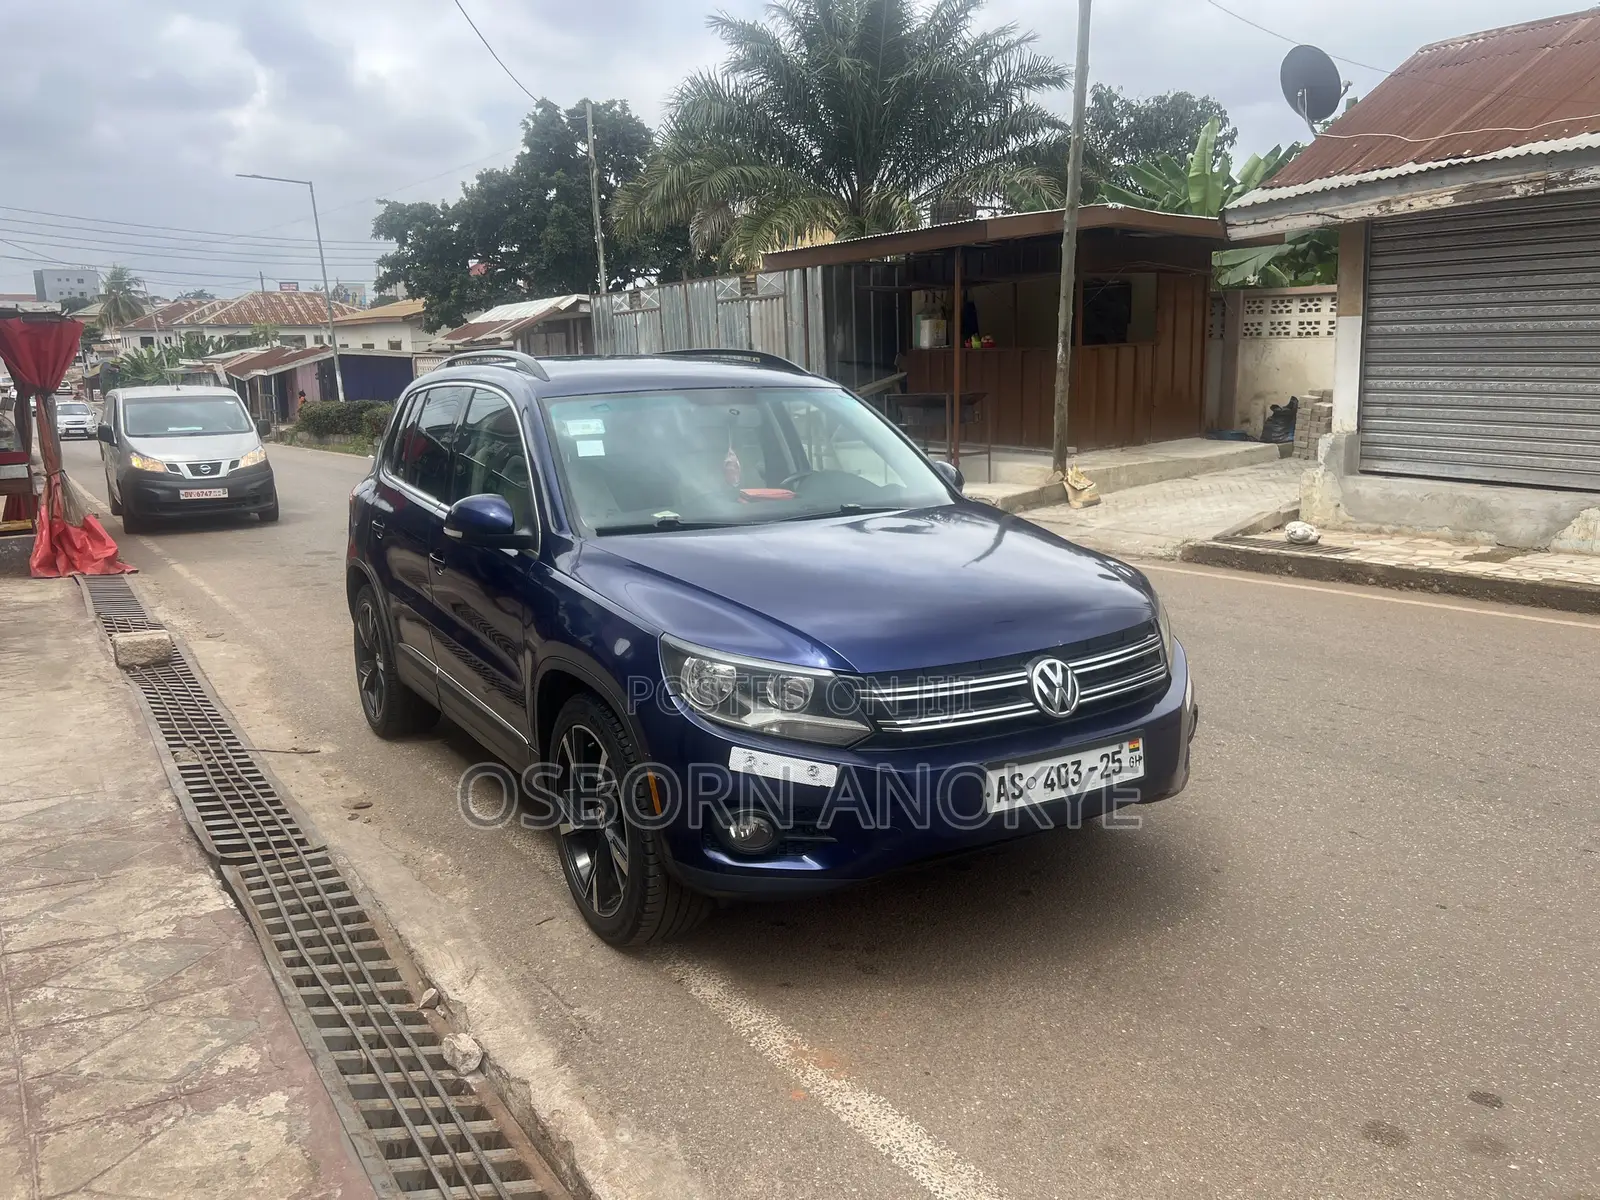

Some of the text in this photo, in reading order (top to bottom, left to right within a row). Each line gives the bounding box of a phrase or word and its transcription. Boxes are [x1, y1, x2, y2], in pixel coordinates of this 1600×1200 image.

[1033, 658, 1079, 717] VW
[1128, 755, 1142, 769] GH
[996, 772, 1024, 804] AS
